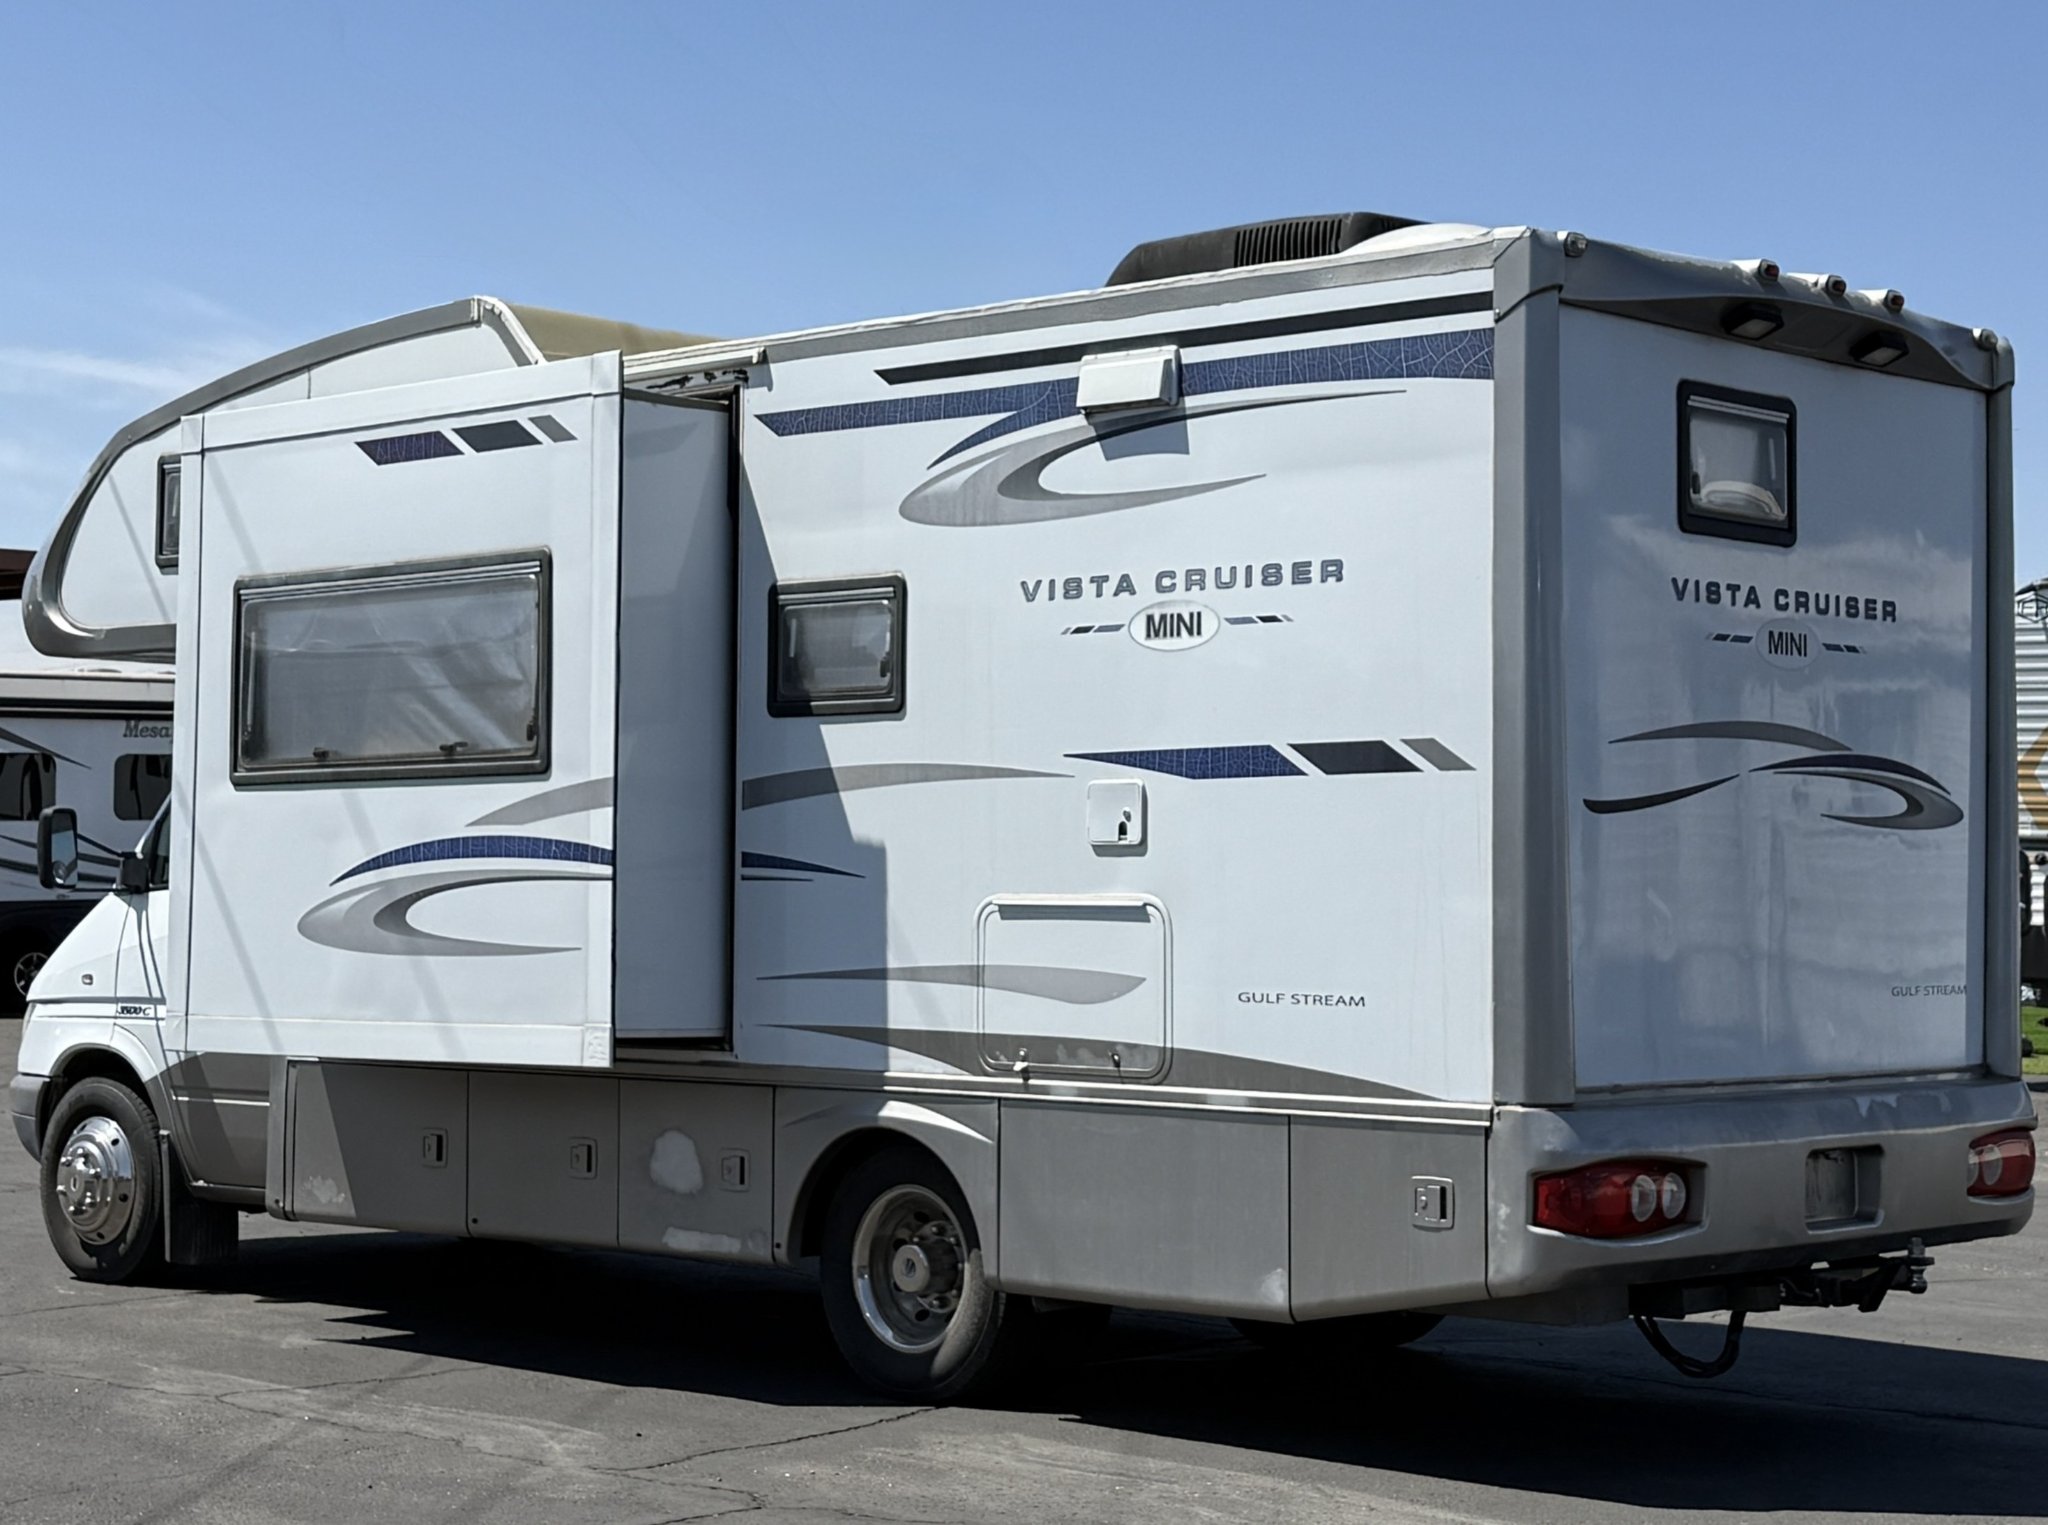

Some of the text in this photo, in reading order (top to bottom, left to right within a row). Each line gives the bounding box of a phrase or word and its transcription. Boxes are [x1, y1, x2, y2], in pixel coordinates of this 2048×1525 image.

[1020, 559, 1344, 602] VISTA CRUISER
[1671, 577, 1897, 623] VISTA CRUISER
[1144, 611, 1203, 641] MINI
[1768, 630, 1807, 657] MINI
[1238, 992, 1366, 1007] GULF STREAM
[1891, 984, 1967, 997] GULF STREAM
